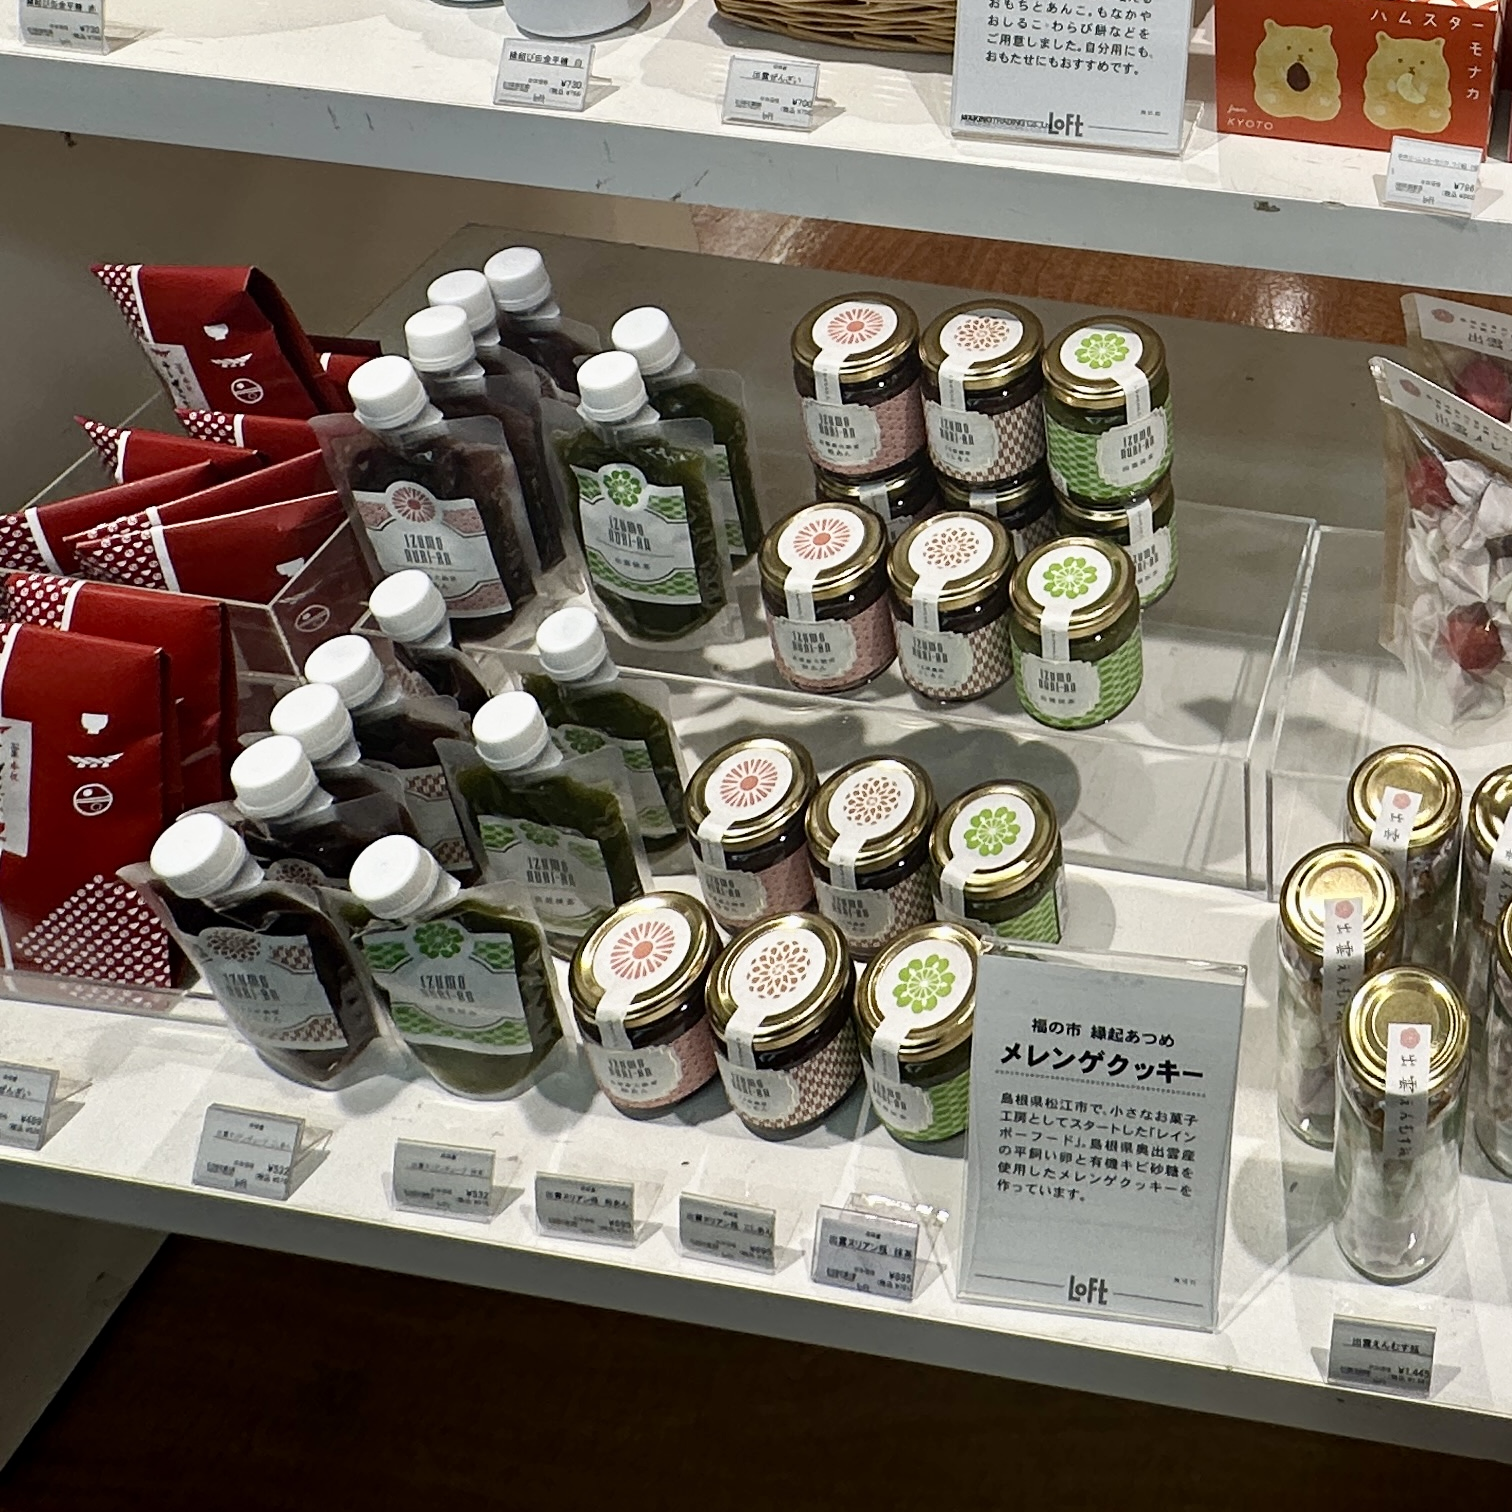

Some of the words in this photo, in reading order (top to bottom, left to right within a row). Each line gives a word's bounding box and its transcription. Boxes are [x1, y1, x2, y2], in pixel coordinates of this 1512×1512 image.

[1370, 9, 1485, 31] ハムスター
[987, 33, 1154, 59] ご用意しました。自分用にも、
[985, 50, 1139, 76] おもたせにもおすすめです。
[1466, 41, 1483, 100] モナカ
[561, 79, 582, 90] ¥730
[792, 98, 813, 109] ¥700
[1227, 118, 1274, 132] KYOTO
[1031, 1017, 1082, 1037] 福の市
[1090, 1024, 1175, 1048] 縁起あつめ
[1000, 1042, 1203, 1084] メレンゲクッキー
[1000, 1091, 1198, 1127] 島根県松江市で、小さなお菓子
[1001, 1111, 1196, 1143] 工房としてスタートした「レイン
[999, 1127, 1195, 1162] ボーフード」。島根県奥出雲産
[998, 1145, 1194, 1179] の平飼い卵と有機キビ砂糖を
[997, 1178, 1086, 1202] 作っています。
[998, 1161, 1192, 1198] 使用したメレンゲクッキーを
